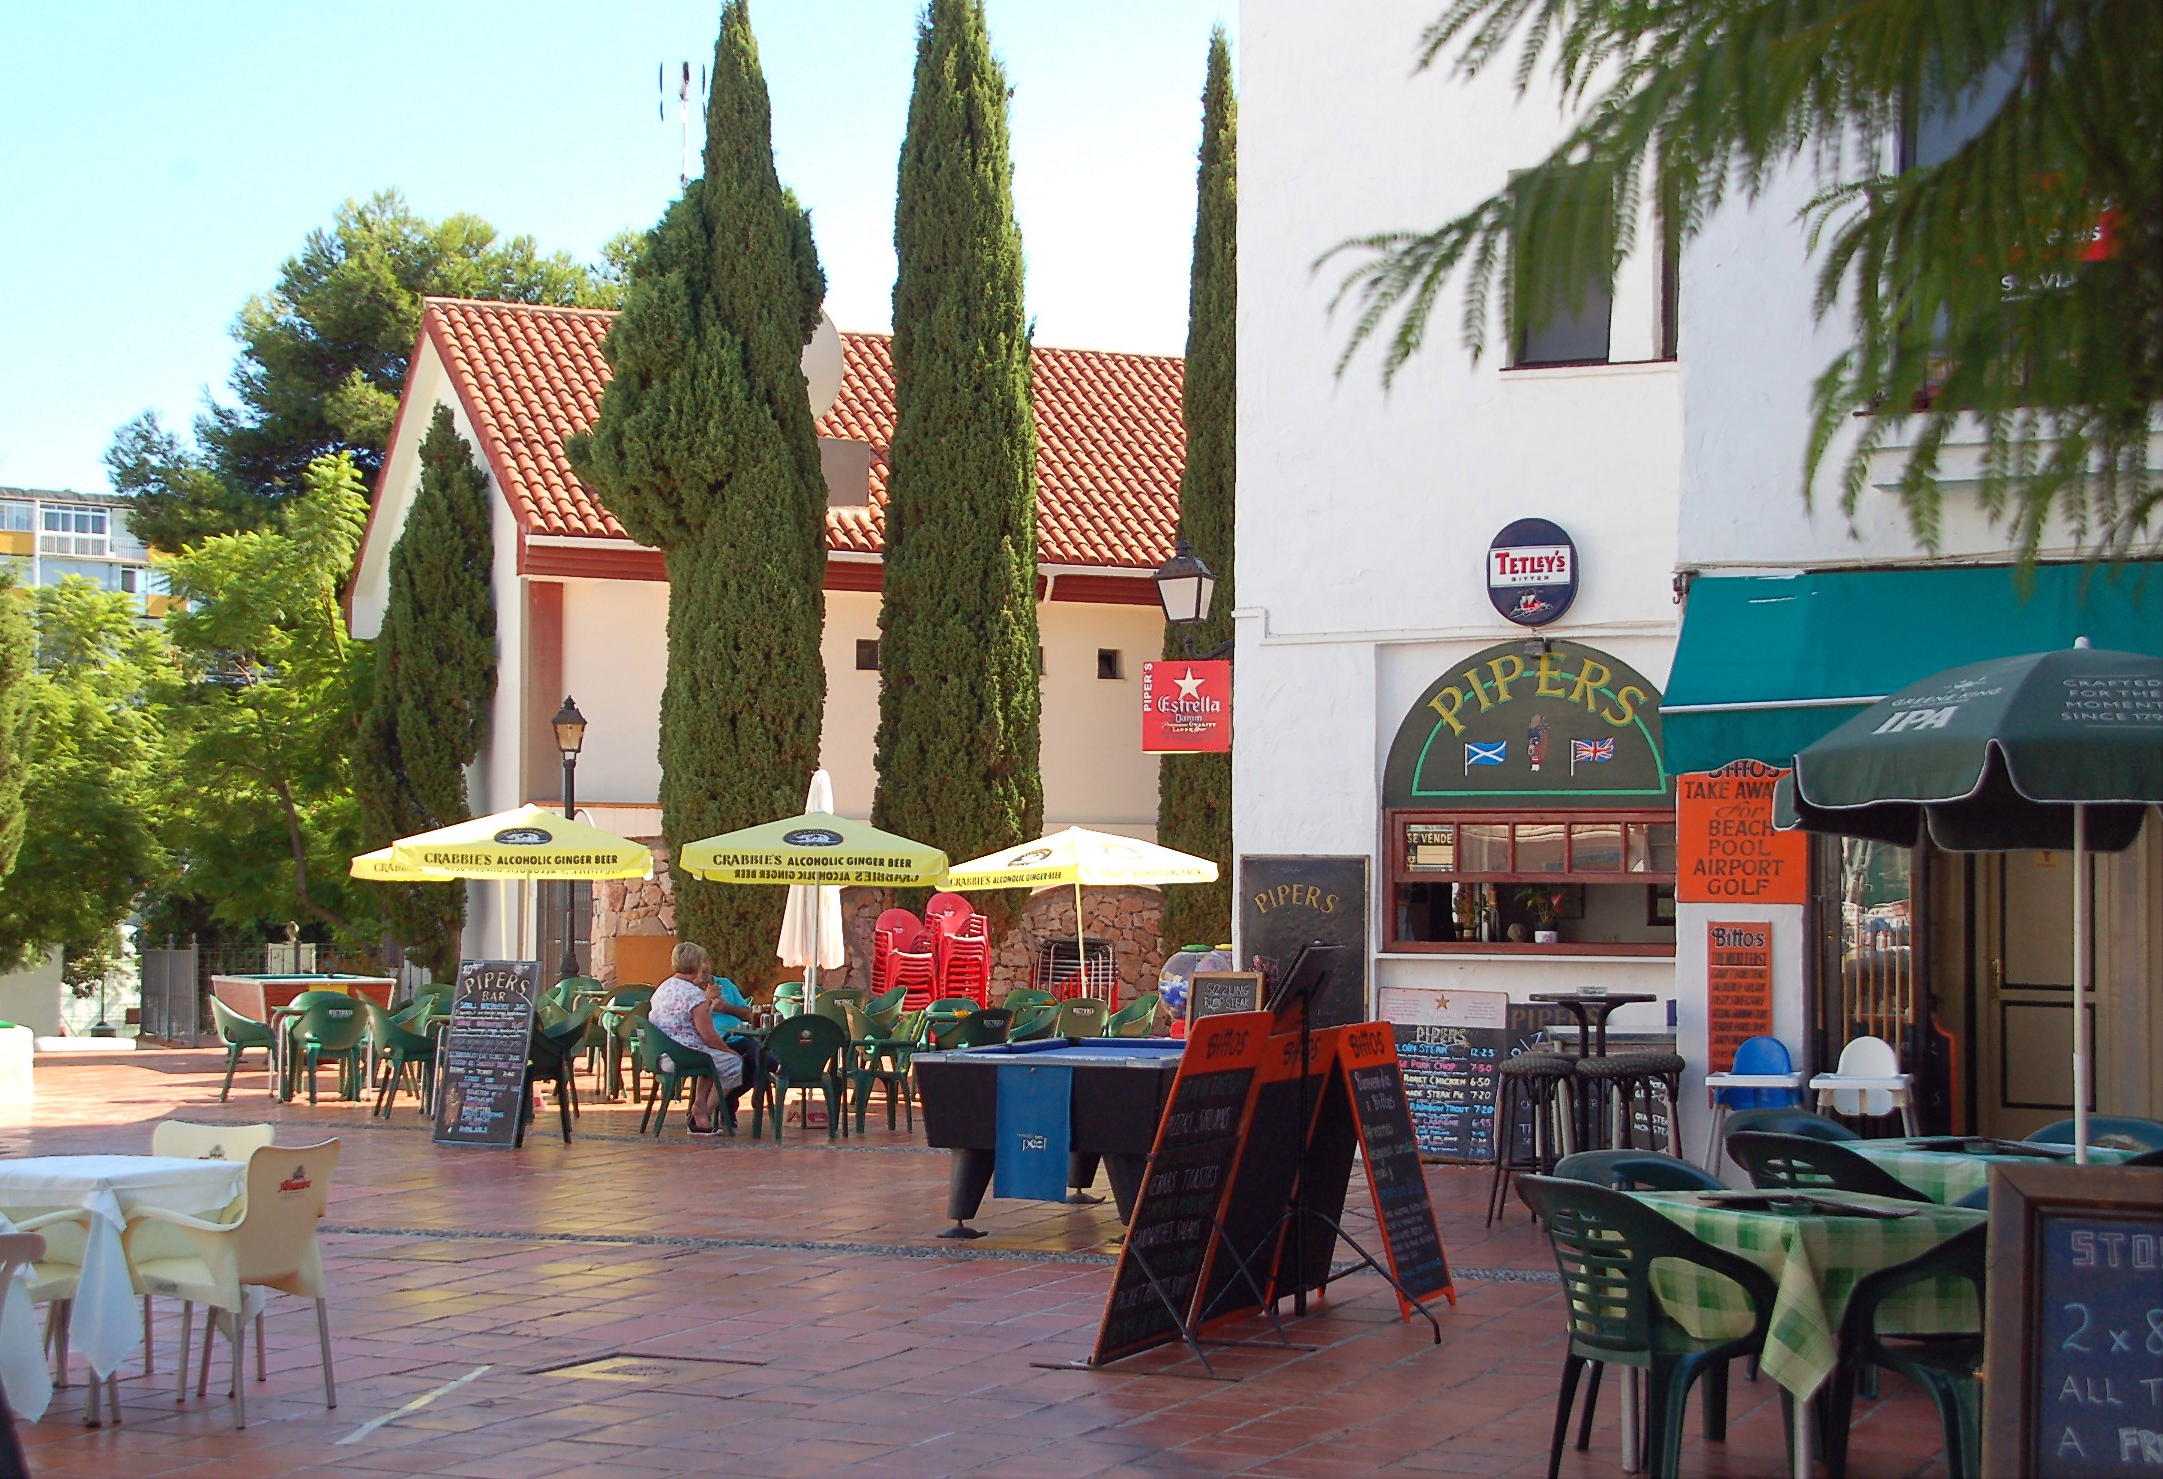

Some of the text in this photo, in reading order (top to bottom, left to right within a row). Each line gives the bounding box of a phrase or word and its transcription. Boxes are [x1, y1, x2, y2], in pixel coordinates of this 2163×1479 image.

[1494, 550, 1566, 575] TETLEY'S
[1143, 662, 1153, 712] PIPER'S
[2063, 679, 2161, 687] CRAFTED
[1427, 653, 1648, 736] PIPERS
[2069, 689, 2162, 698] FOR THE
[1157, 695, 1221, 713] Estrella
[1871, 705, 1960, 735] IPA
[2061, 711, 2127, 721] SINCE
[1684, 781, 1729, 800] TAKE
[1708, 819, 1775, 837] BEACH
[1406, 832, 1453, 844] SE VENDE
[1708, 839, 1772, 856] POOL
[424, 852, 618, 865] CRABBIE'S ALCOHOLIC GINGER BEER
[713, 853, 912, 868] CRABBIE'S ALCOHOLIC GINGER BEER
[1692, 859, 1784, 876] AIRPORT
[1707, 879, 1769, 896] GOLF
[1254, 883, 1339, 914] PIPERS
[1711, 926, 1765, 947] Bittos
[464, 971, 530, 996] PIPERS
[482, 990, 506, 1003] BAR
[1206, 1029, 1248, 1059] Bittos
[1349, 1031, 1385, 1058] Bittos
[1416, 1025, 1467, 1046] PIPERS
[1420, 1043, 1448, 1054] STEAK
[1429, 1075, 1467, 1086] CHICKEN
[1426, 1090, 1451, 1099] STEAK
[2071, 1231, 2163, 1268] STO
[2062, 1302, 2092, 1351] 2
[2058, 1375, 2122, 1405] ALL
[2057, 1426, 2163, 1465] A FR
